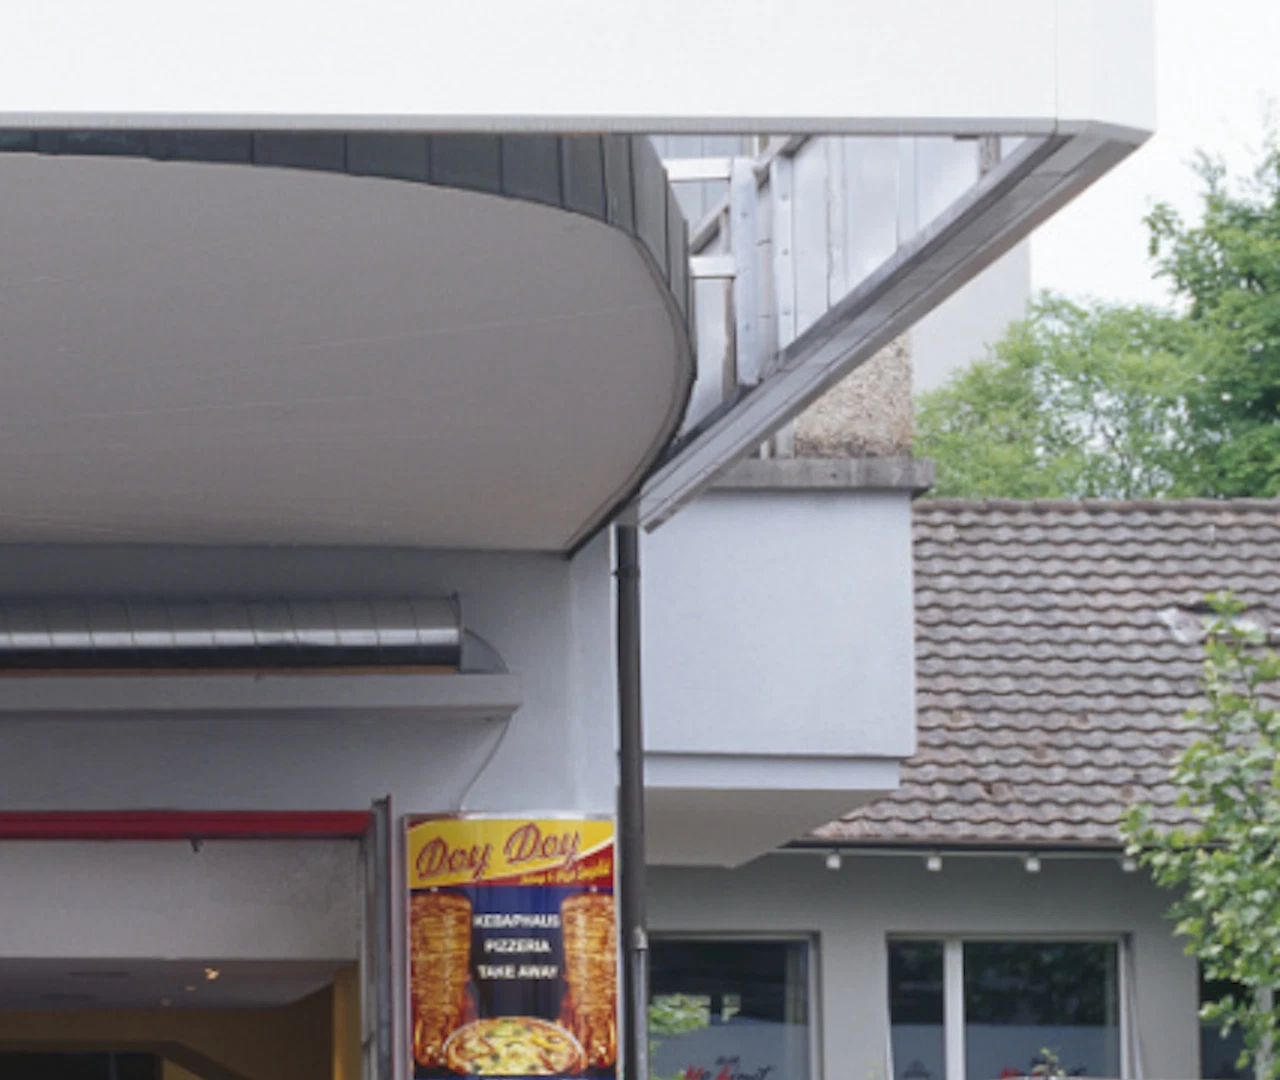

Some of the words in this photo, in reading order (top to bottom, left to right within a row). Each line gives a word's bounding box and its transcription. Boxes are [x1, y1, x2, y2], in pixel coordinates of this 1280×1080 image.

[415, 836, 493, 881] Doy
[503, 821, 580, 870] Doy
[473, 913, 561, 929] KEBAPHAUS
[483, 939, 551, 954] PIZZERIA
[476, 964, 517, 980] TAKE
[518, 964, 560, 980] AWAY
